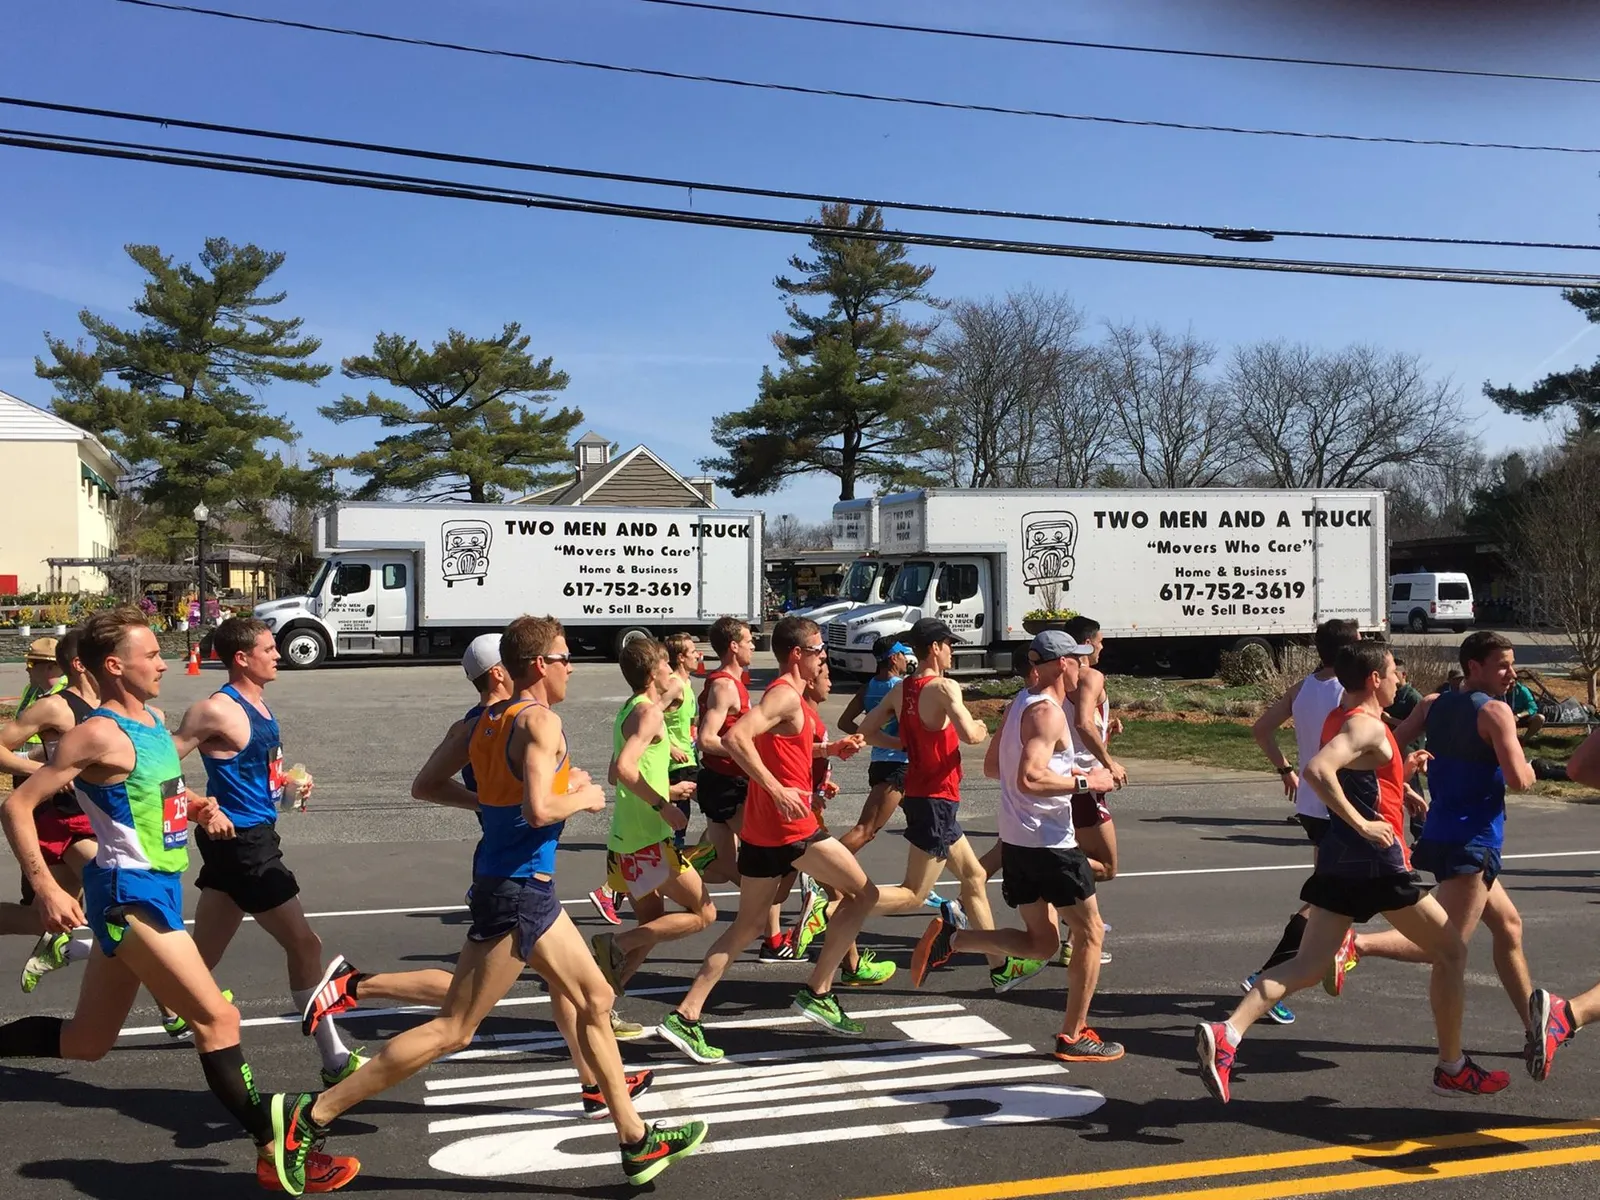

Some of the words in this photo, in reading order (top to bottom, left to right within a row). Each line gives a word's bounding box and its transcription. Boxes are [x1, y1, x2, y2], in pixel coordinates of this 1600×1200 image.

[893, 511, 904, 520] TWO
[1093, 510, 1149, 530] TWO
[1159, 510, 1208, 529] MEN
[1218, 510, 1266, 529] AND
[1276, 510, 1291, 528] A
[1301, 509, 1372, 528] TRUCK
[504, 520, 555, 536] TWO
[563, 520, 607, 537] MEN
[615, 522, 658, 537] AND
[666, 522, 680, 538] A
[689, 522, 751, 539] TRUCK
[896, 531, 910, 540] TRUCK
[622, 545, 655, 557] Who
[1224, 539, 1261, 554] Who
[579, 564, 611, 574] Home
[616, 564, 626, 574] &
[630, 565, 679, 574] Business
[1175, 566, 1212, 578] Home
[1216, 565, 1228, 577] &
[1233, 565, 1287, 577] Business
[562, 581, 692, 597] 617-752-3619
[1159, 581, 1306, 601] 617-752-3619
[582, 604, 603, 615] We
[608, 604, 631, 614] Sell
[636, 604, 674, 614] Boxes
[1181, 604, 1205, 617] We
[1210, 603, 1237, 616] Sell
[1242, 603, 1286, 615] Boxes
